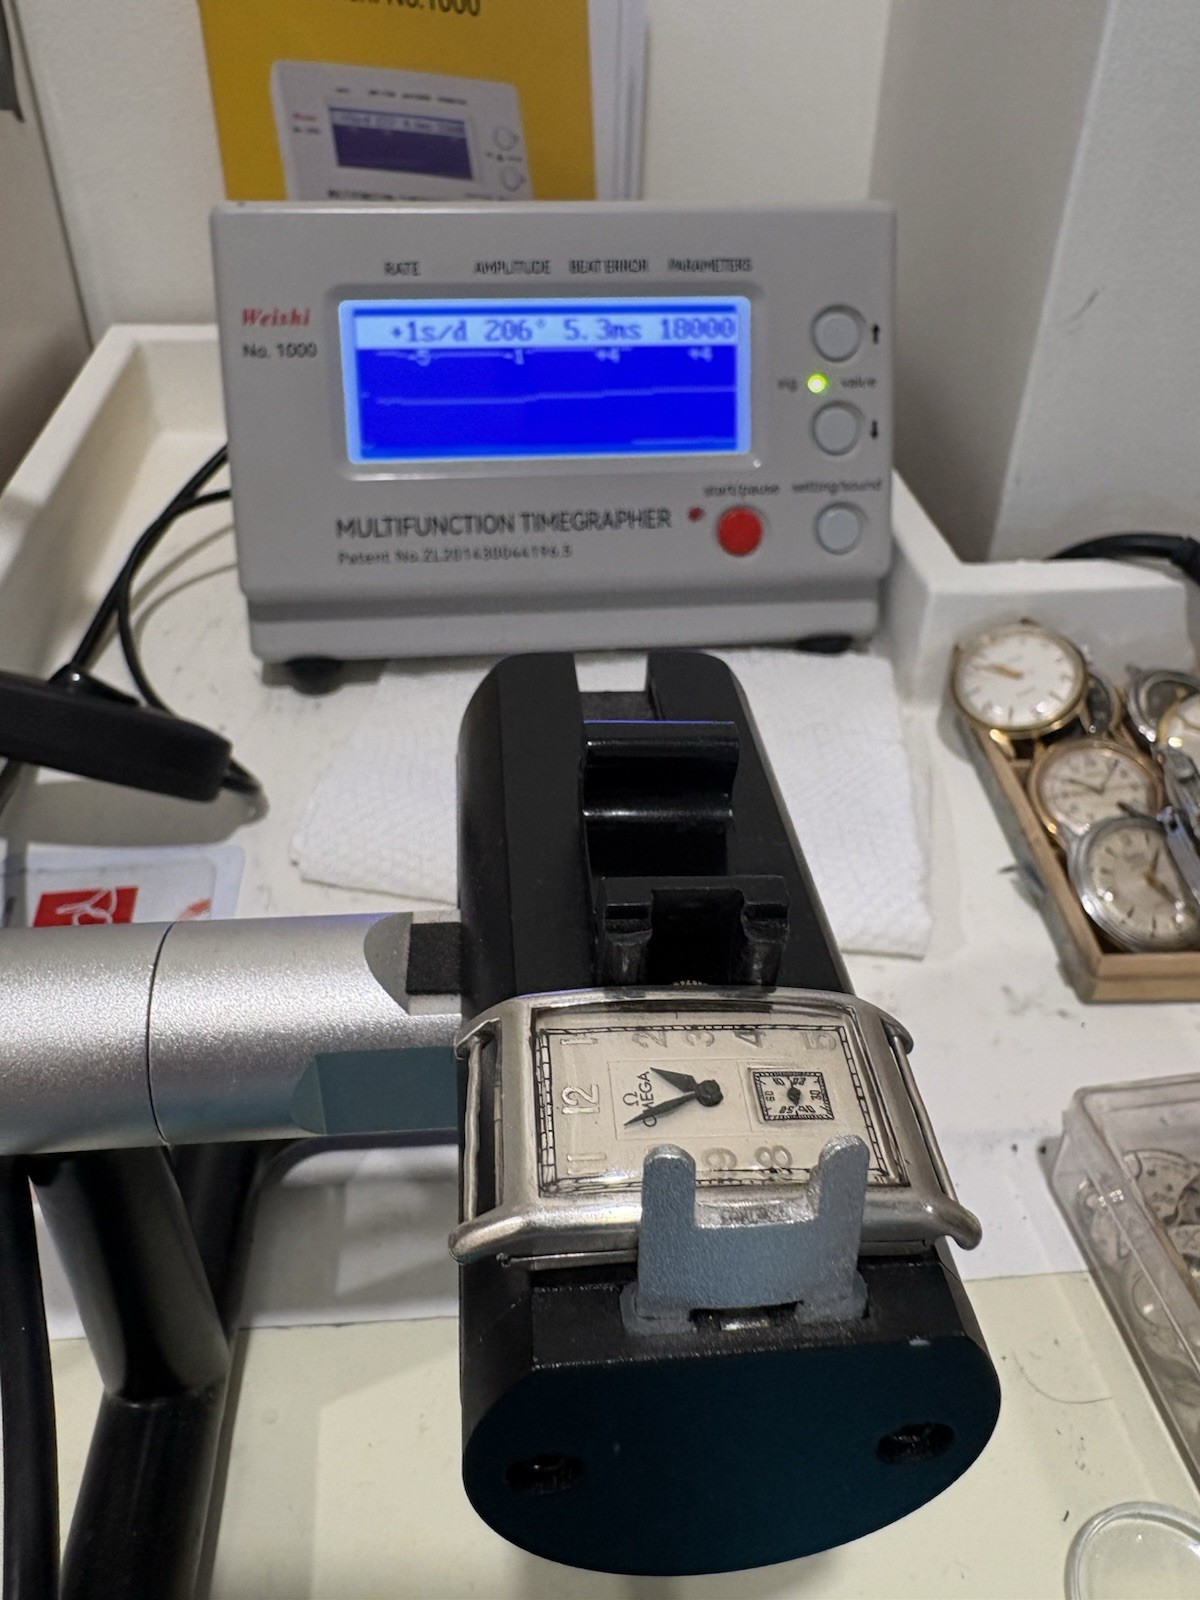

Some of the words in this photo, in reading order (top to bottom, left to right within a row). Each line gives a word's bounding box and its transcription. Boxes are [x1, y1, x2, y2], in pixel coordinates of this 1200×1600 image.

[384, 261, 420, 276] RATE
[475, 260, 551, 275] AMPLITUDE
[569, 259, 600, 274] BEAT
[604, 258, 648, 274] ERROR
[668, 258, 752, 273] PARAMETERS
[242, 307, 311, 327] Weishi
[563, 317, 642, 341] 5.3ms
[660, 316, 736, 340] 18000
[242, 343, 271, 358] No.
[276, 342, 318, 358] 1000
[336, 513, 516, 538] MULTIFUNCTION
[521, 506, 672, 533] TIMEGRAPHER
[338, 550, 391, 565] Patent
[732, 1028, 767, 1048] 4
[561, 1084, 600, 1114] 12
[637, 1070, 658, 1128] OMEGA
